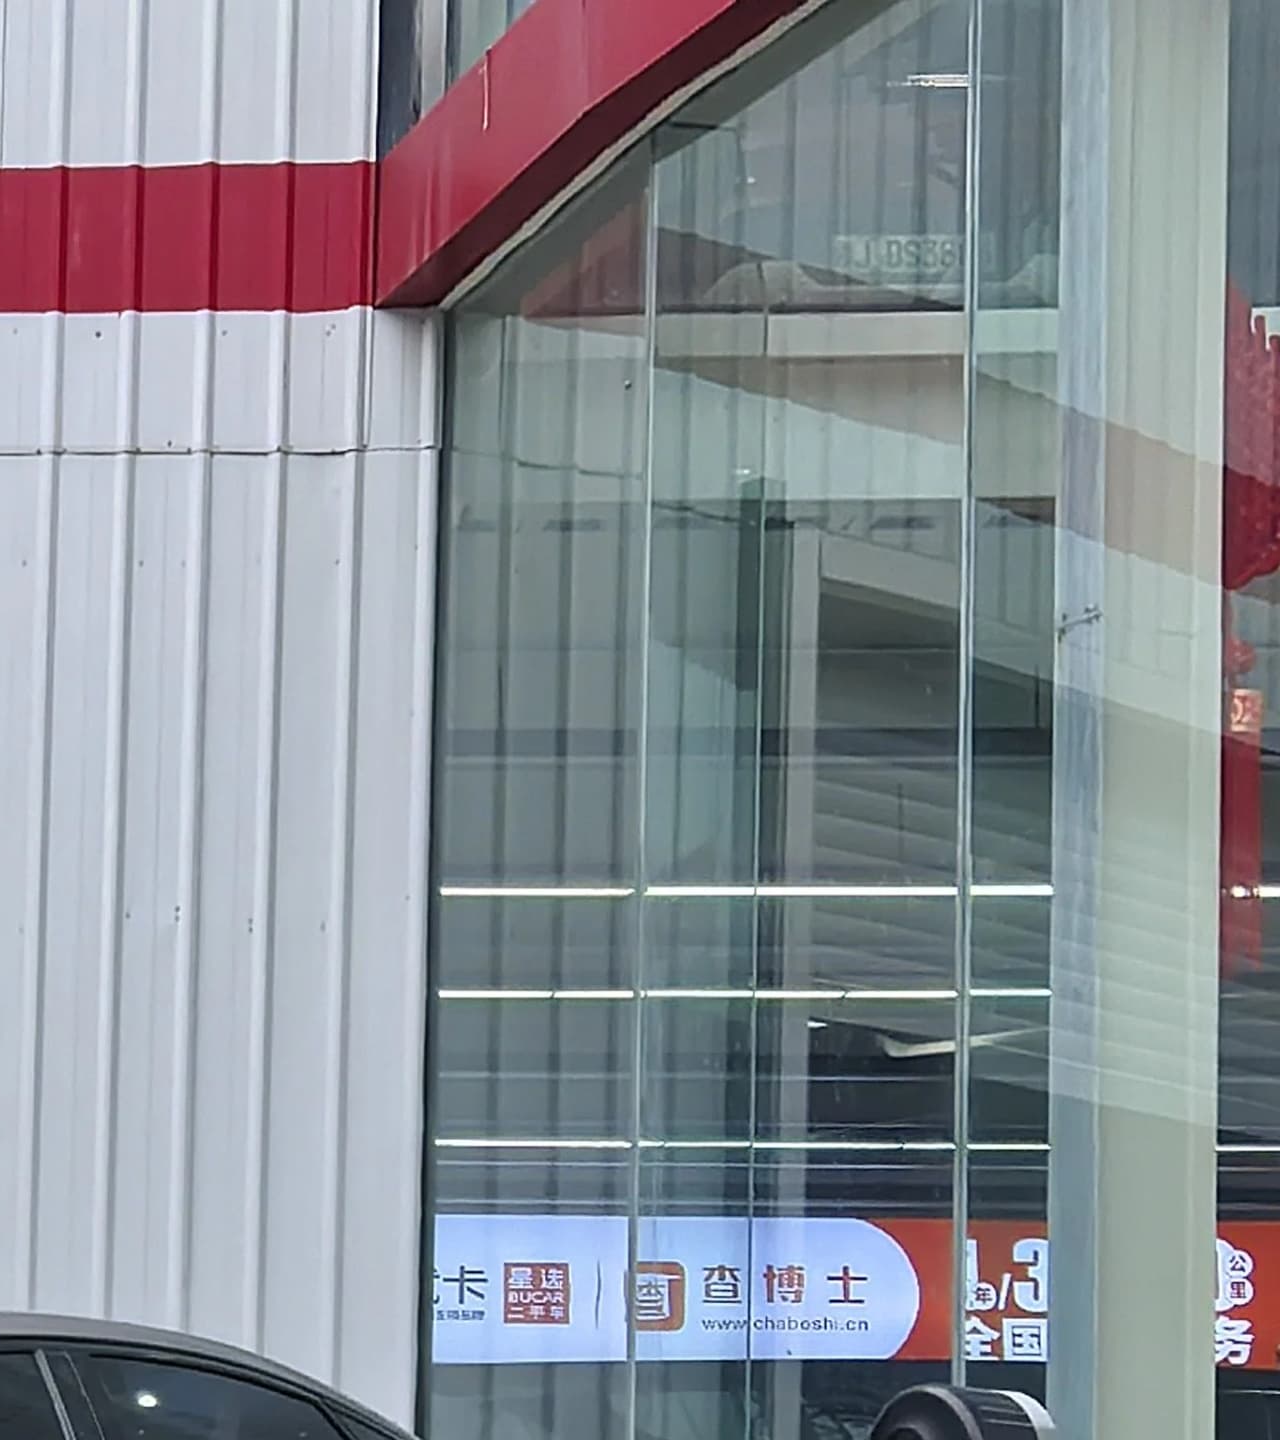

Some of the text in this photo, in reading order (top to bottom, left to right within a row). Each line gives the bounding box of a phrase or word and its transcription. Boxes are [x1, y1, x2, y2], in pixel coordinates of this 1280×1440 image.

[507, 1267, 564, 1291] 星选
[702, 1264, 869, 1305] 查博士
[507, 1291, 564, 1304] BUCAR
[964, 1316, 1049, 1362] 全国
